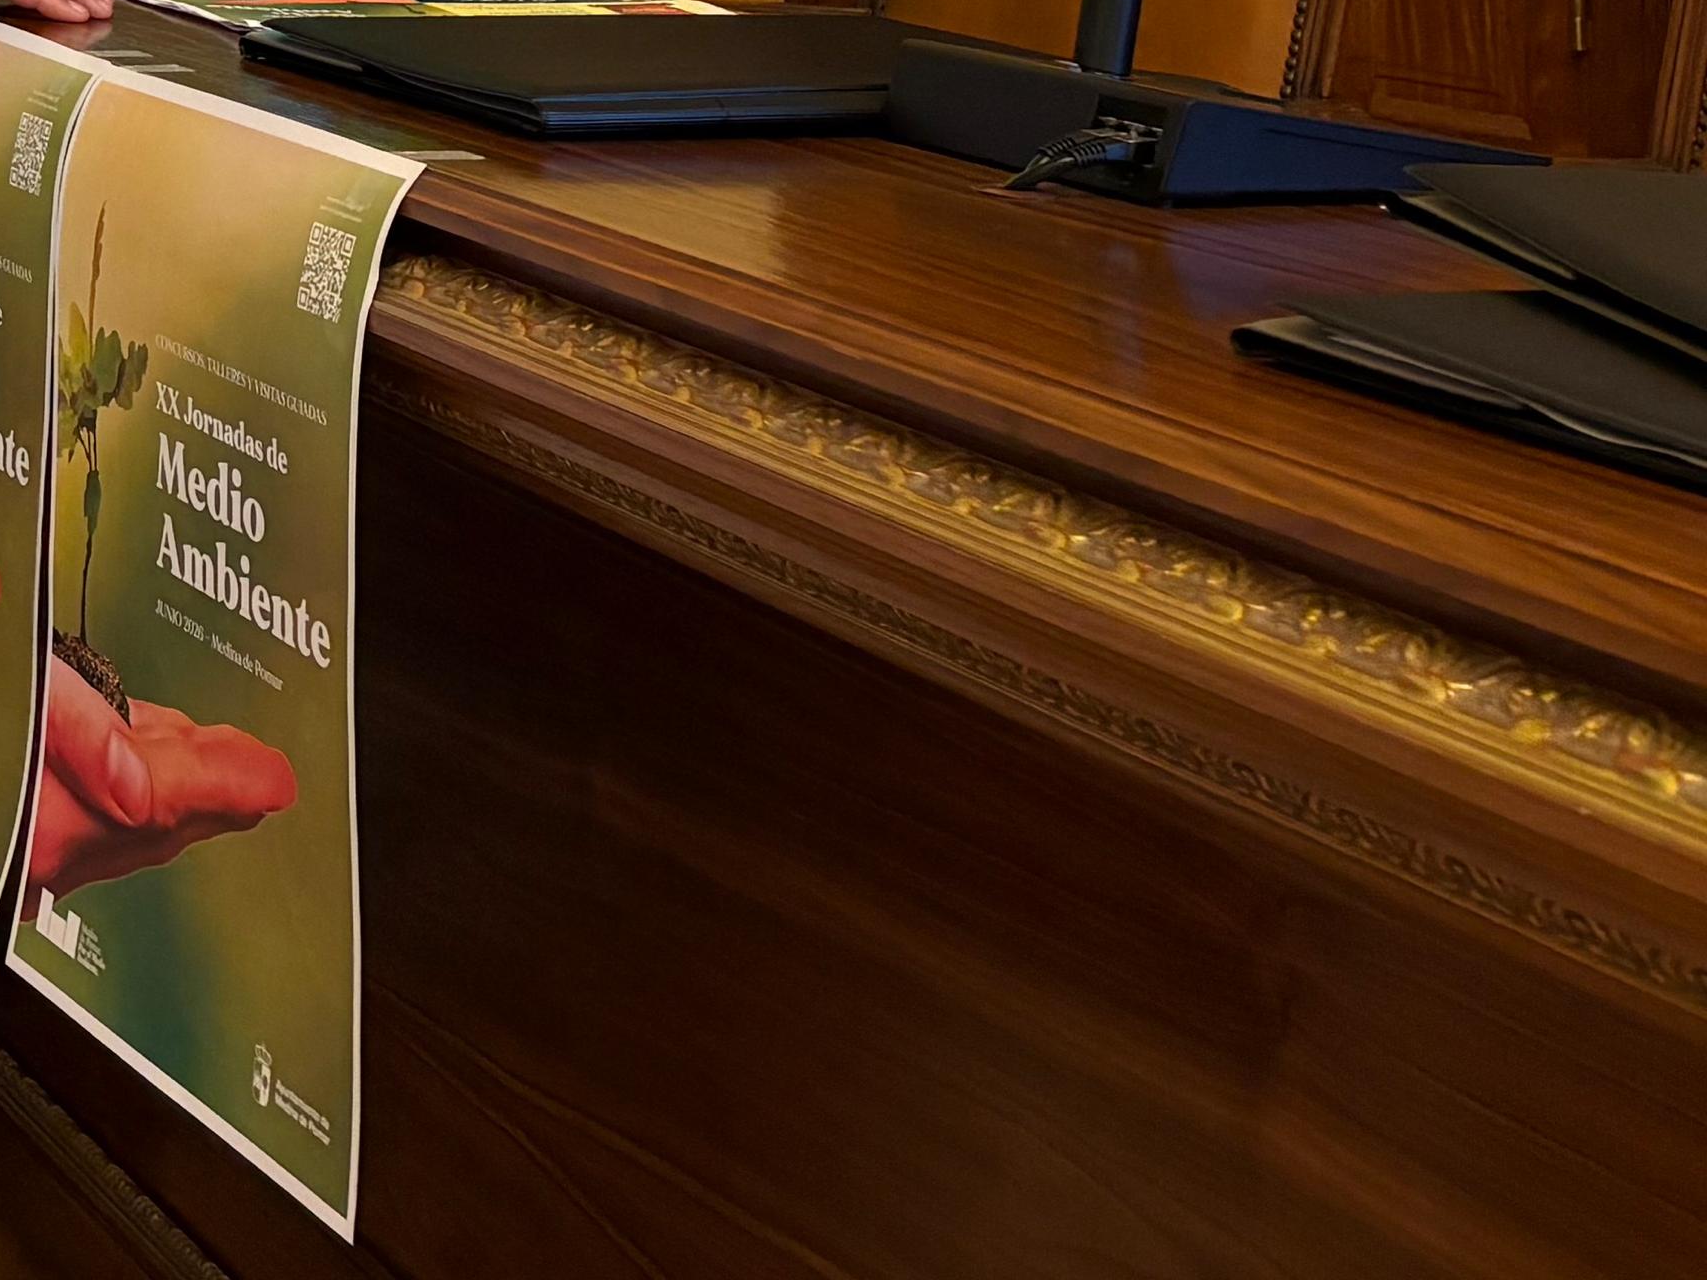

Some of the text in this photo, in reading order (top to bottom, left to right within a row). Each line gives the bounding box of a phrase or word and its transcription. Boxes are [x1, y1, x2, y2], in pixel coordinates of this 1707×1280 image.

[2, 257, 33, 284] GUIADAS
[154, 333, 206, 371] CONCURSOS,
[207, 356, 247, 389] TALLERES
[254, 378, 287, 408] VISITAS
[286, 395, 328, 427] GUIADAS
[155, 380, 288, 475] XX Jornadas de
[156, 432, 266, 543] Medio
[156, 512, 331, 669] Ambiente
[155, 598, 183, 629] JUNIO
[183, 614, 205, 642] 2026
[211, 631, 243, 668] Medina
[242, 653, 255, 674] de
[254, 658, 284, 691] Pomar
